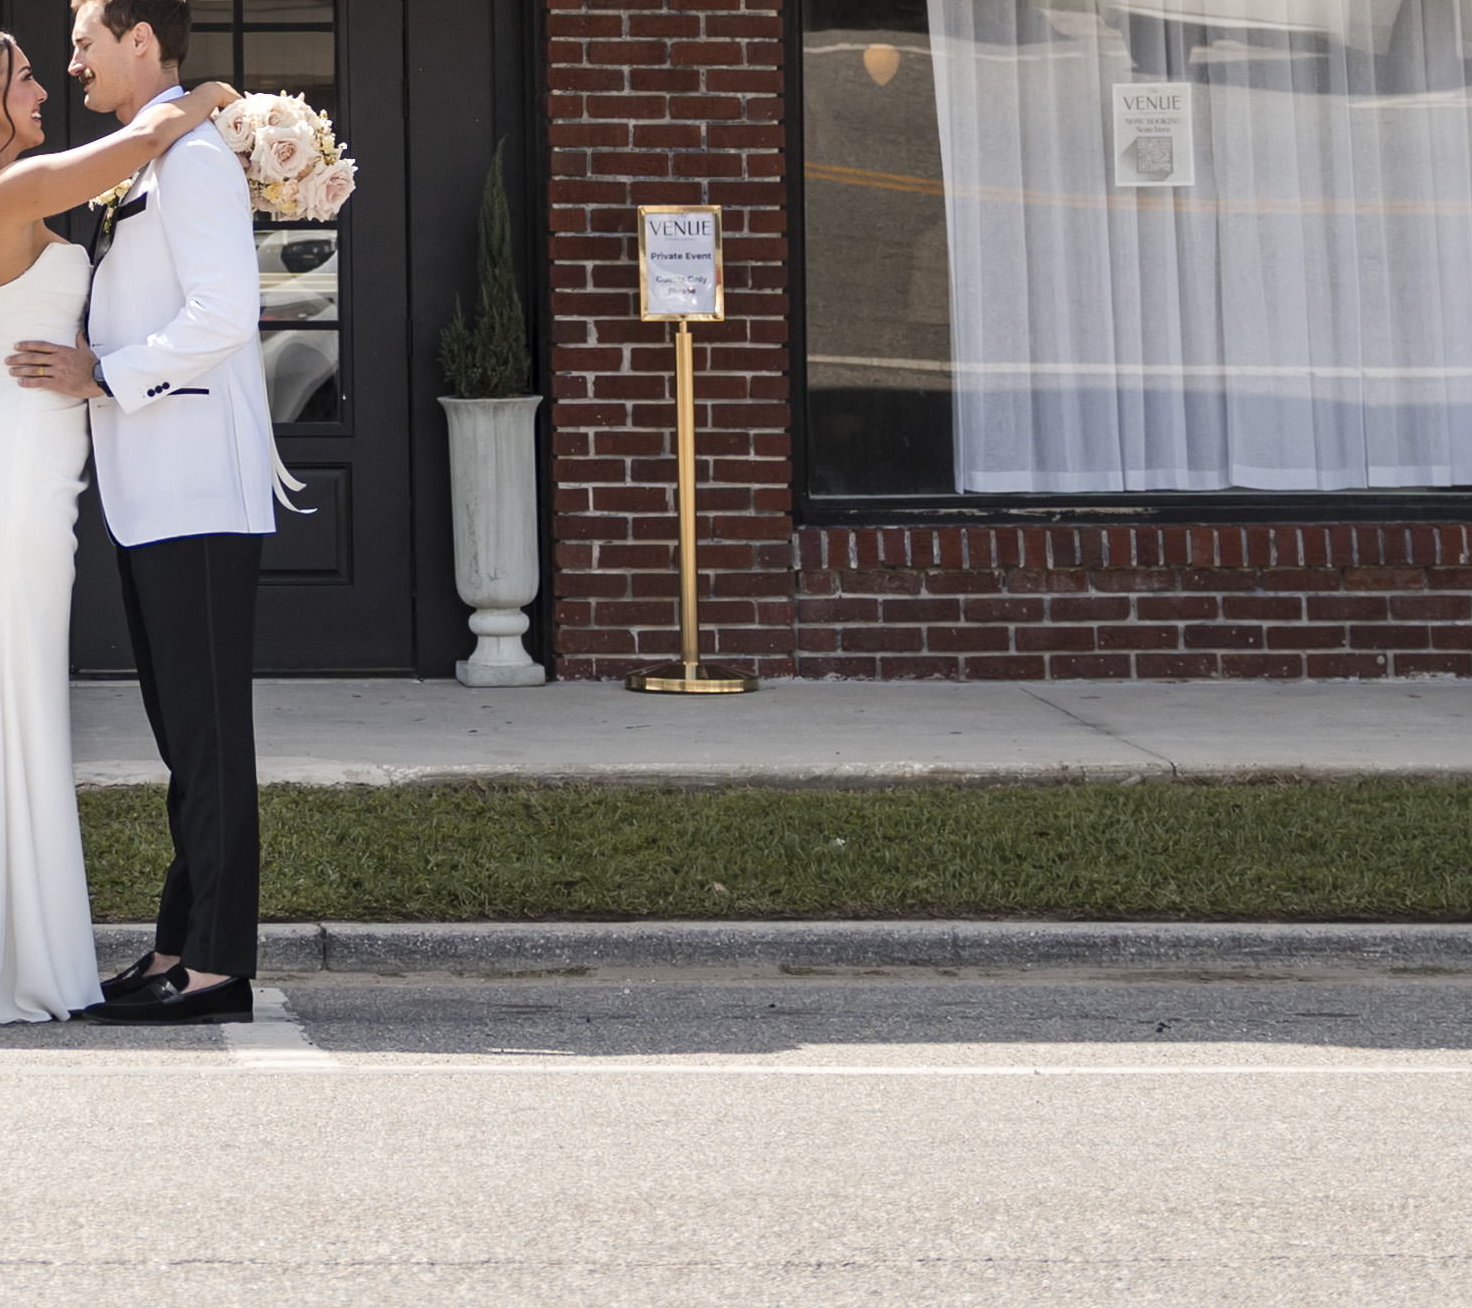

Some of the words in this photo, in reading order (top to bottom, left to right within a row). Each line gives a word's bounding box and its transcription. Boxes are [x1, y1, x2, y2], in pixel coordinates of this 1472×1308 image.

[1123, 95, 1182, 111] VENUE
[1125, 117, 1146, 125] NOW
[1146, 117, 1182, 125] BOOKING
[649, 220, 712, 236] VENUE
[650, 251, 683, 260] Private
[685, 251, 712, 260] Event
[687, 275, 708, 284] Only
